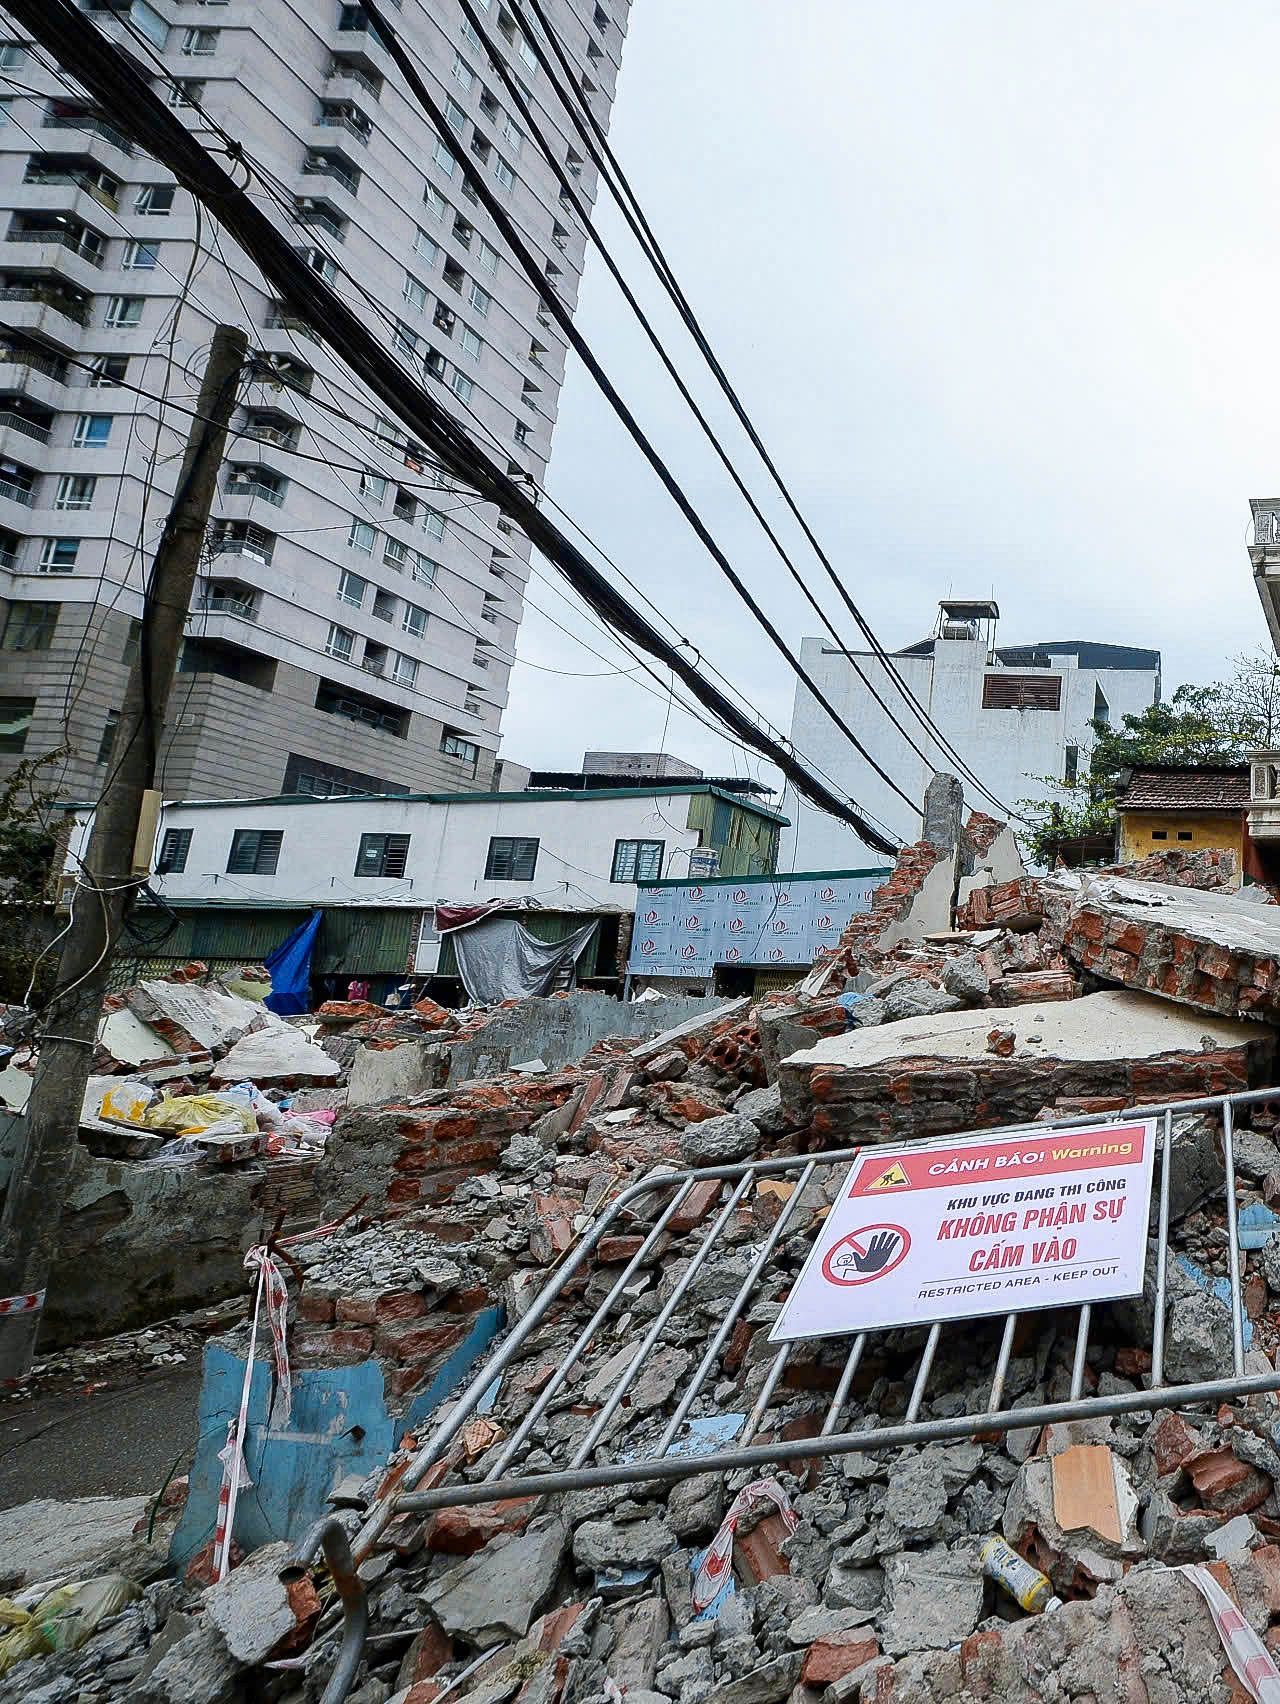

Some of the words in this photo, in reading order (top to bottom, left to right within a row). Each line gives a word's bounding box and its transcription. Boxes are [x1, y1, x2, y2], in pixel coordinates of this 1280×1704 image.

[994, 1151, 1046, 1169] BÁO!
[1051, 1142, 1133, 1161] Warning
[947, 1194, 978, 1211] KHU
[982, 1192, 1011, 1208] VỰC
[1014, 1187, 1055, 1203] ĐANG
[1060, 1183, 1082, 1197] THI
[1086, 1178, 1127, 1193] CÔNG
[936, 1211, 1018, 1241] KHÔNG
[1023, 1201, 1087, 1230] PHẬN
[1093, 1196, 1127, 1224] SỰ
[968, 1239, 1025, 1272] CẤM
[1032, 1236, 1077, 1264] VÀO
[918, 1281, 1002, 1299] RESTRICTED
[1004, 1276, 1041, 1289] AREA
[1053, 1270, 1088, 1282] KEEP
[1092, 1266, 1119, 1277] OUT
